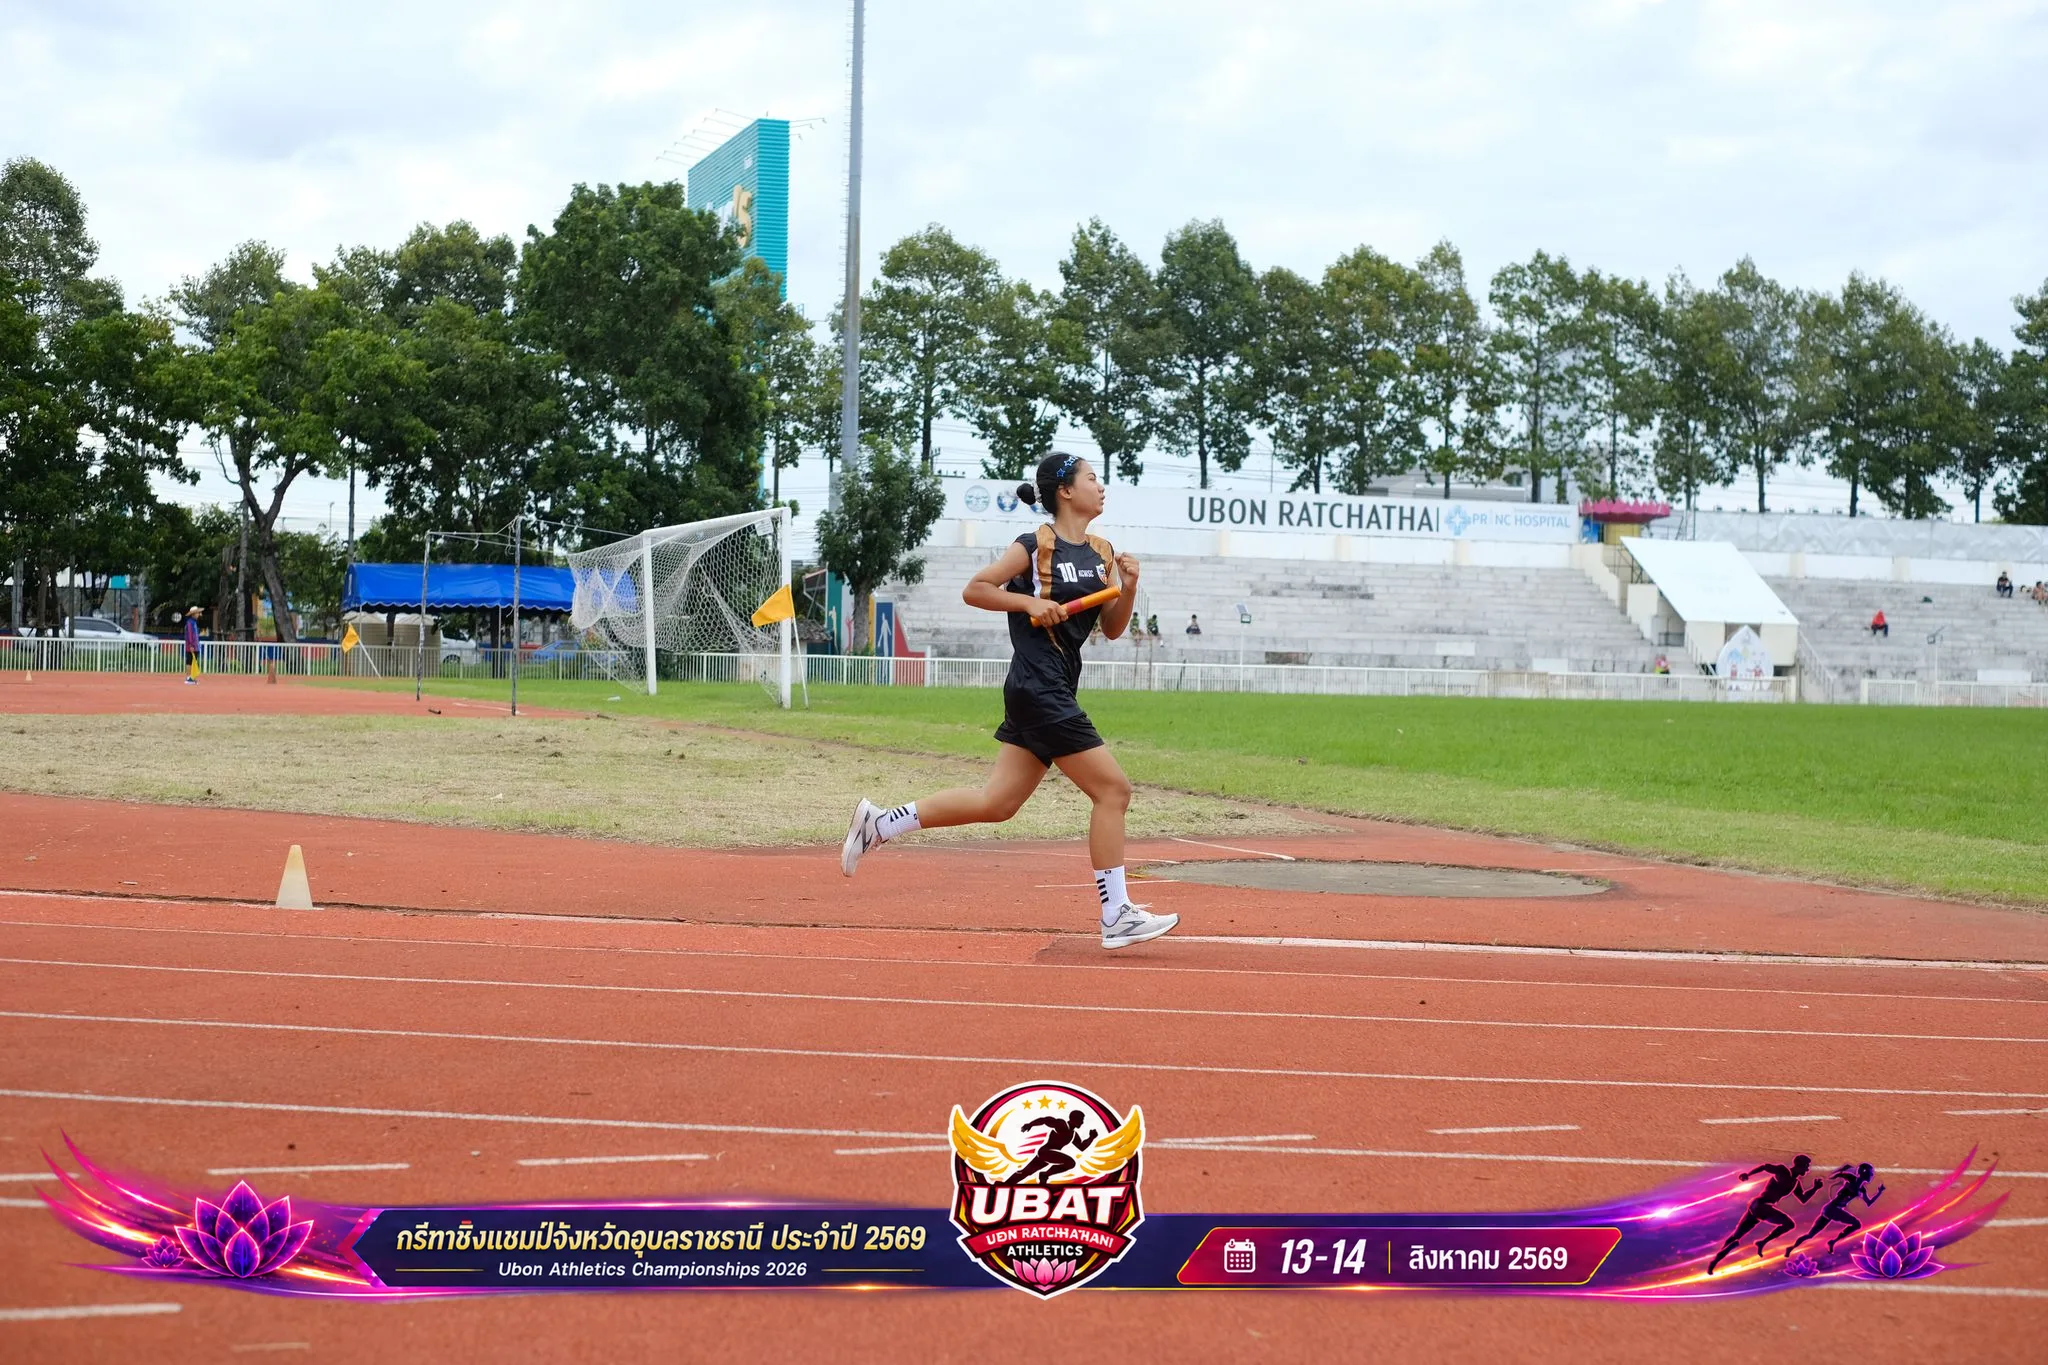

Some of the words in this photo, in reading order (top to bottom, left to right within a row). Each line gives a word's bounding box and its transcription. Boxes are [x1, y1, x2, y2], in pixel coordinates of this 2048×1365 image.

[1188, 496, 1267, 526] UBON
[1514, 514, 1571, 529] HOSPITAL
[1056, 562, 1078, 583] 10
